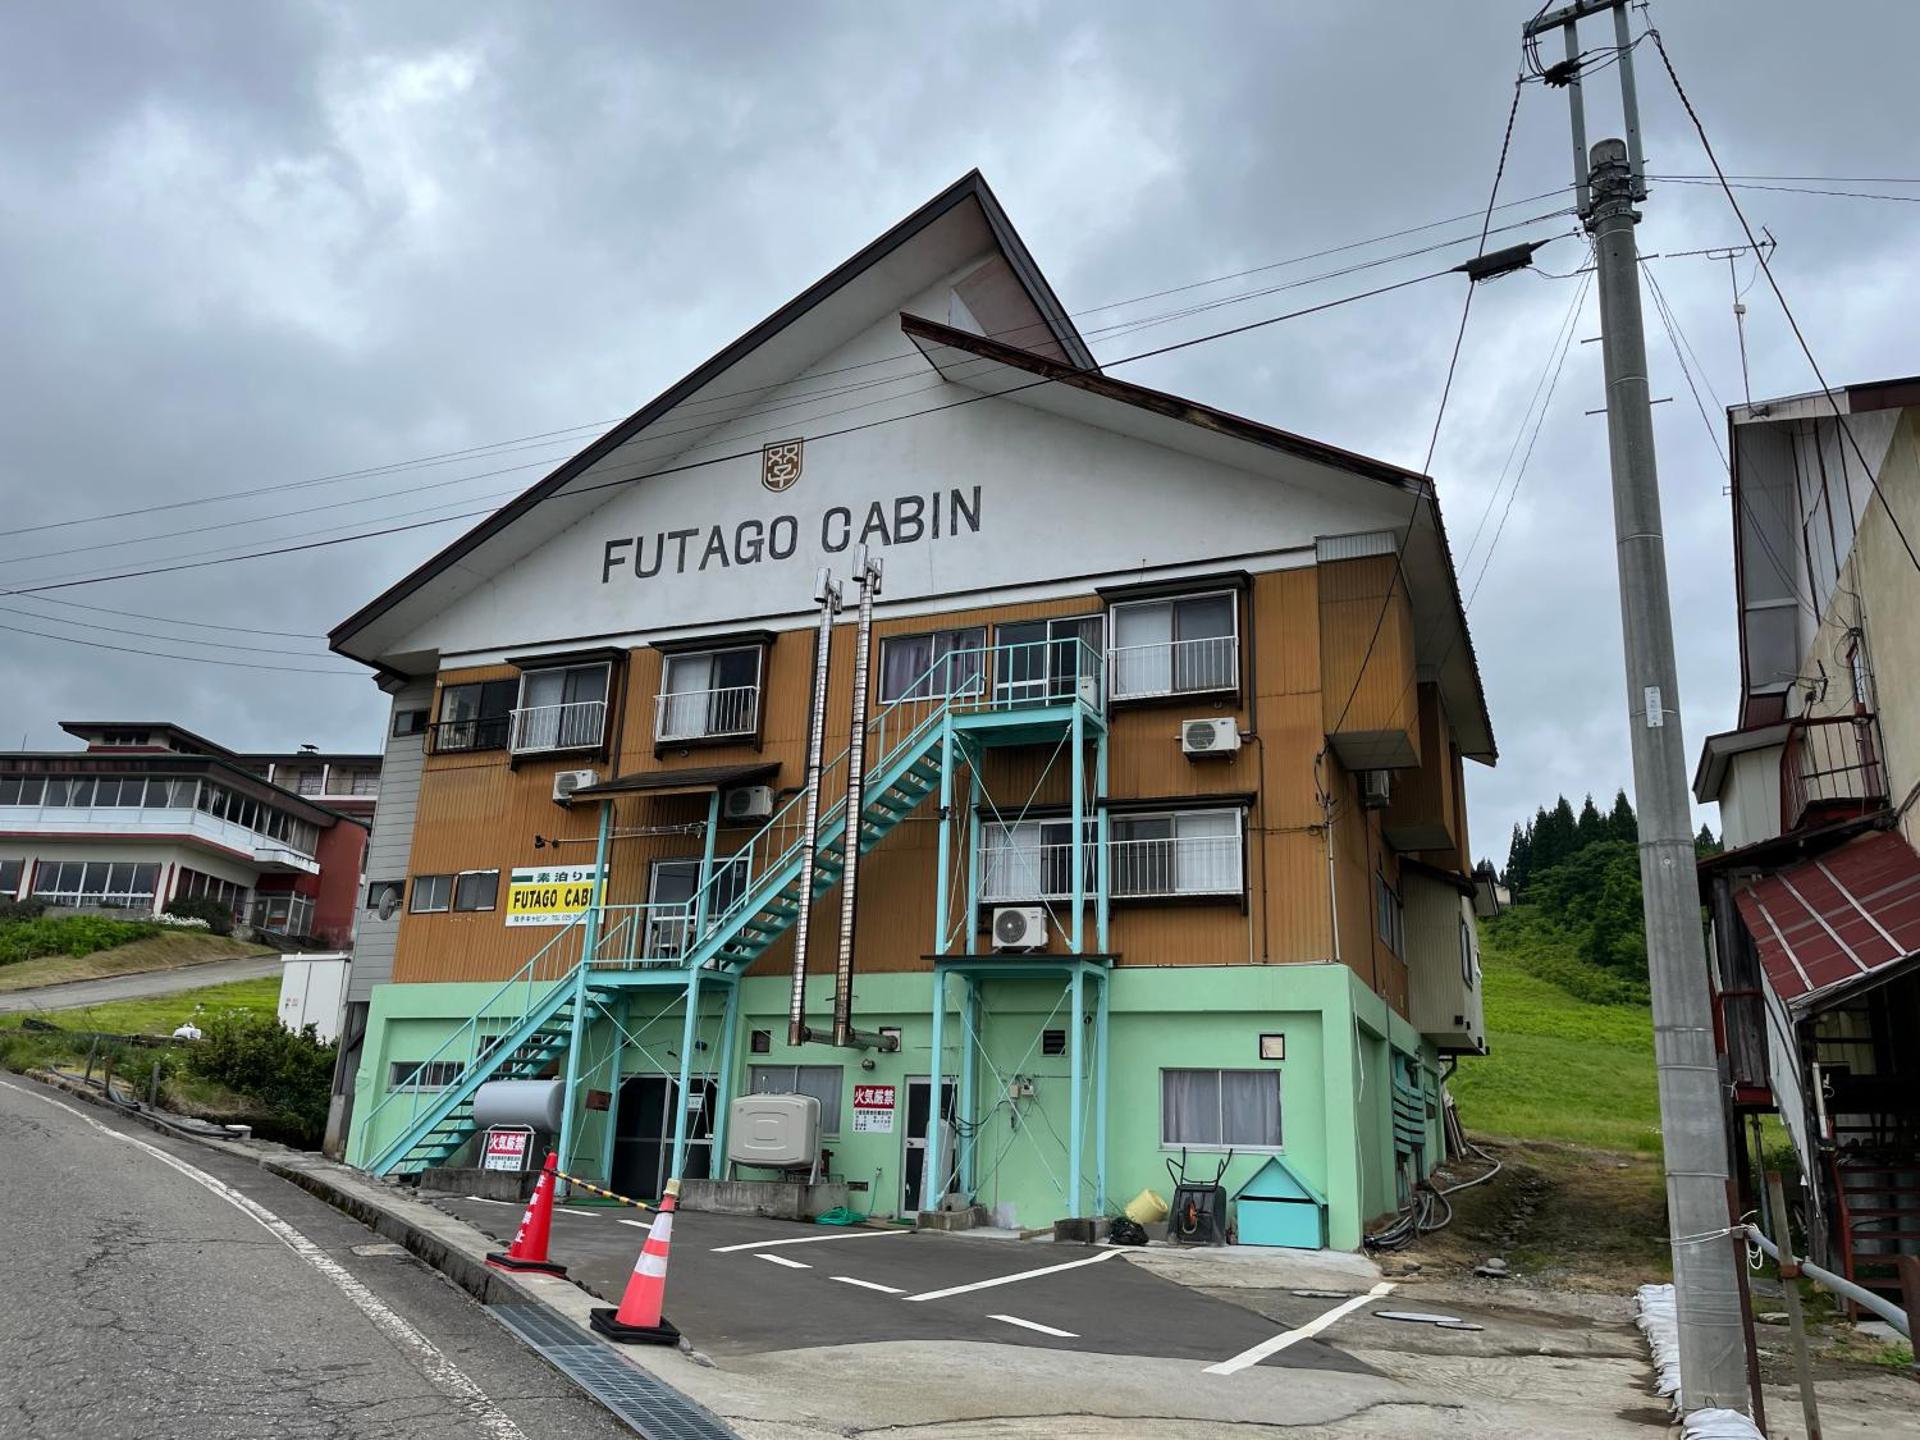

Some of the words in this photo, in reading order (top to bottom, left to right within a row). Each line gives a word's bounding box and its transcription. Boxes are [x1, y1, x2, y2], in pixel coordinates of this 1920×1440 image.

[601, 514, 799, 584] FUTAGO
[821, 486, 982, 553] CABIN
[537, 871, 582, 883] 素泊り
[513, 889, 558, 909] FUTAGO
[564, 887, 593, 907] CABI
[854, 1088, 894, 1105] 火気厳禁
[489, 1134, 525, 1151] 火気厳禁
